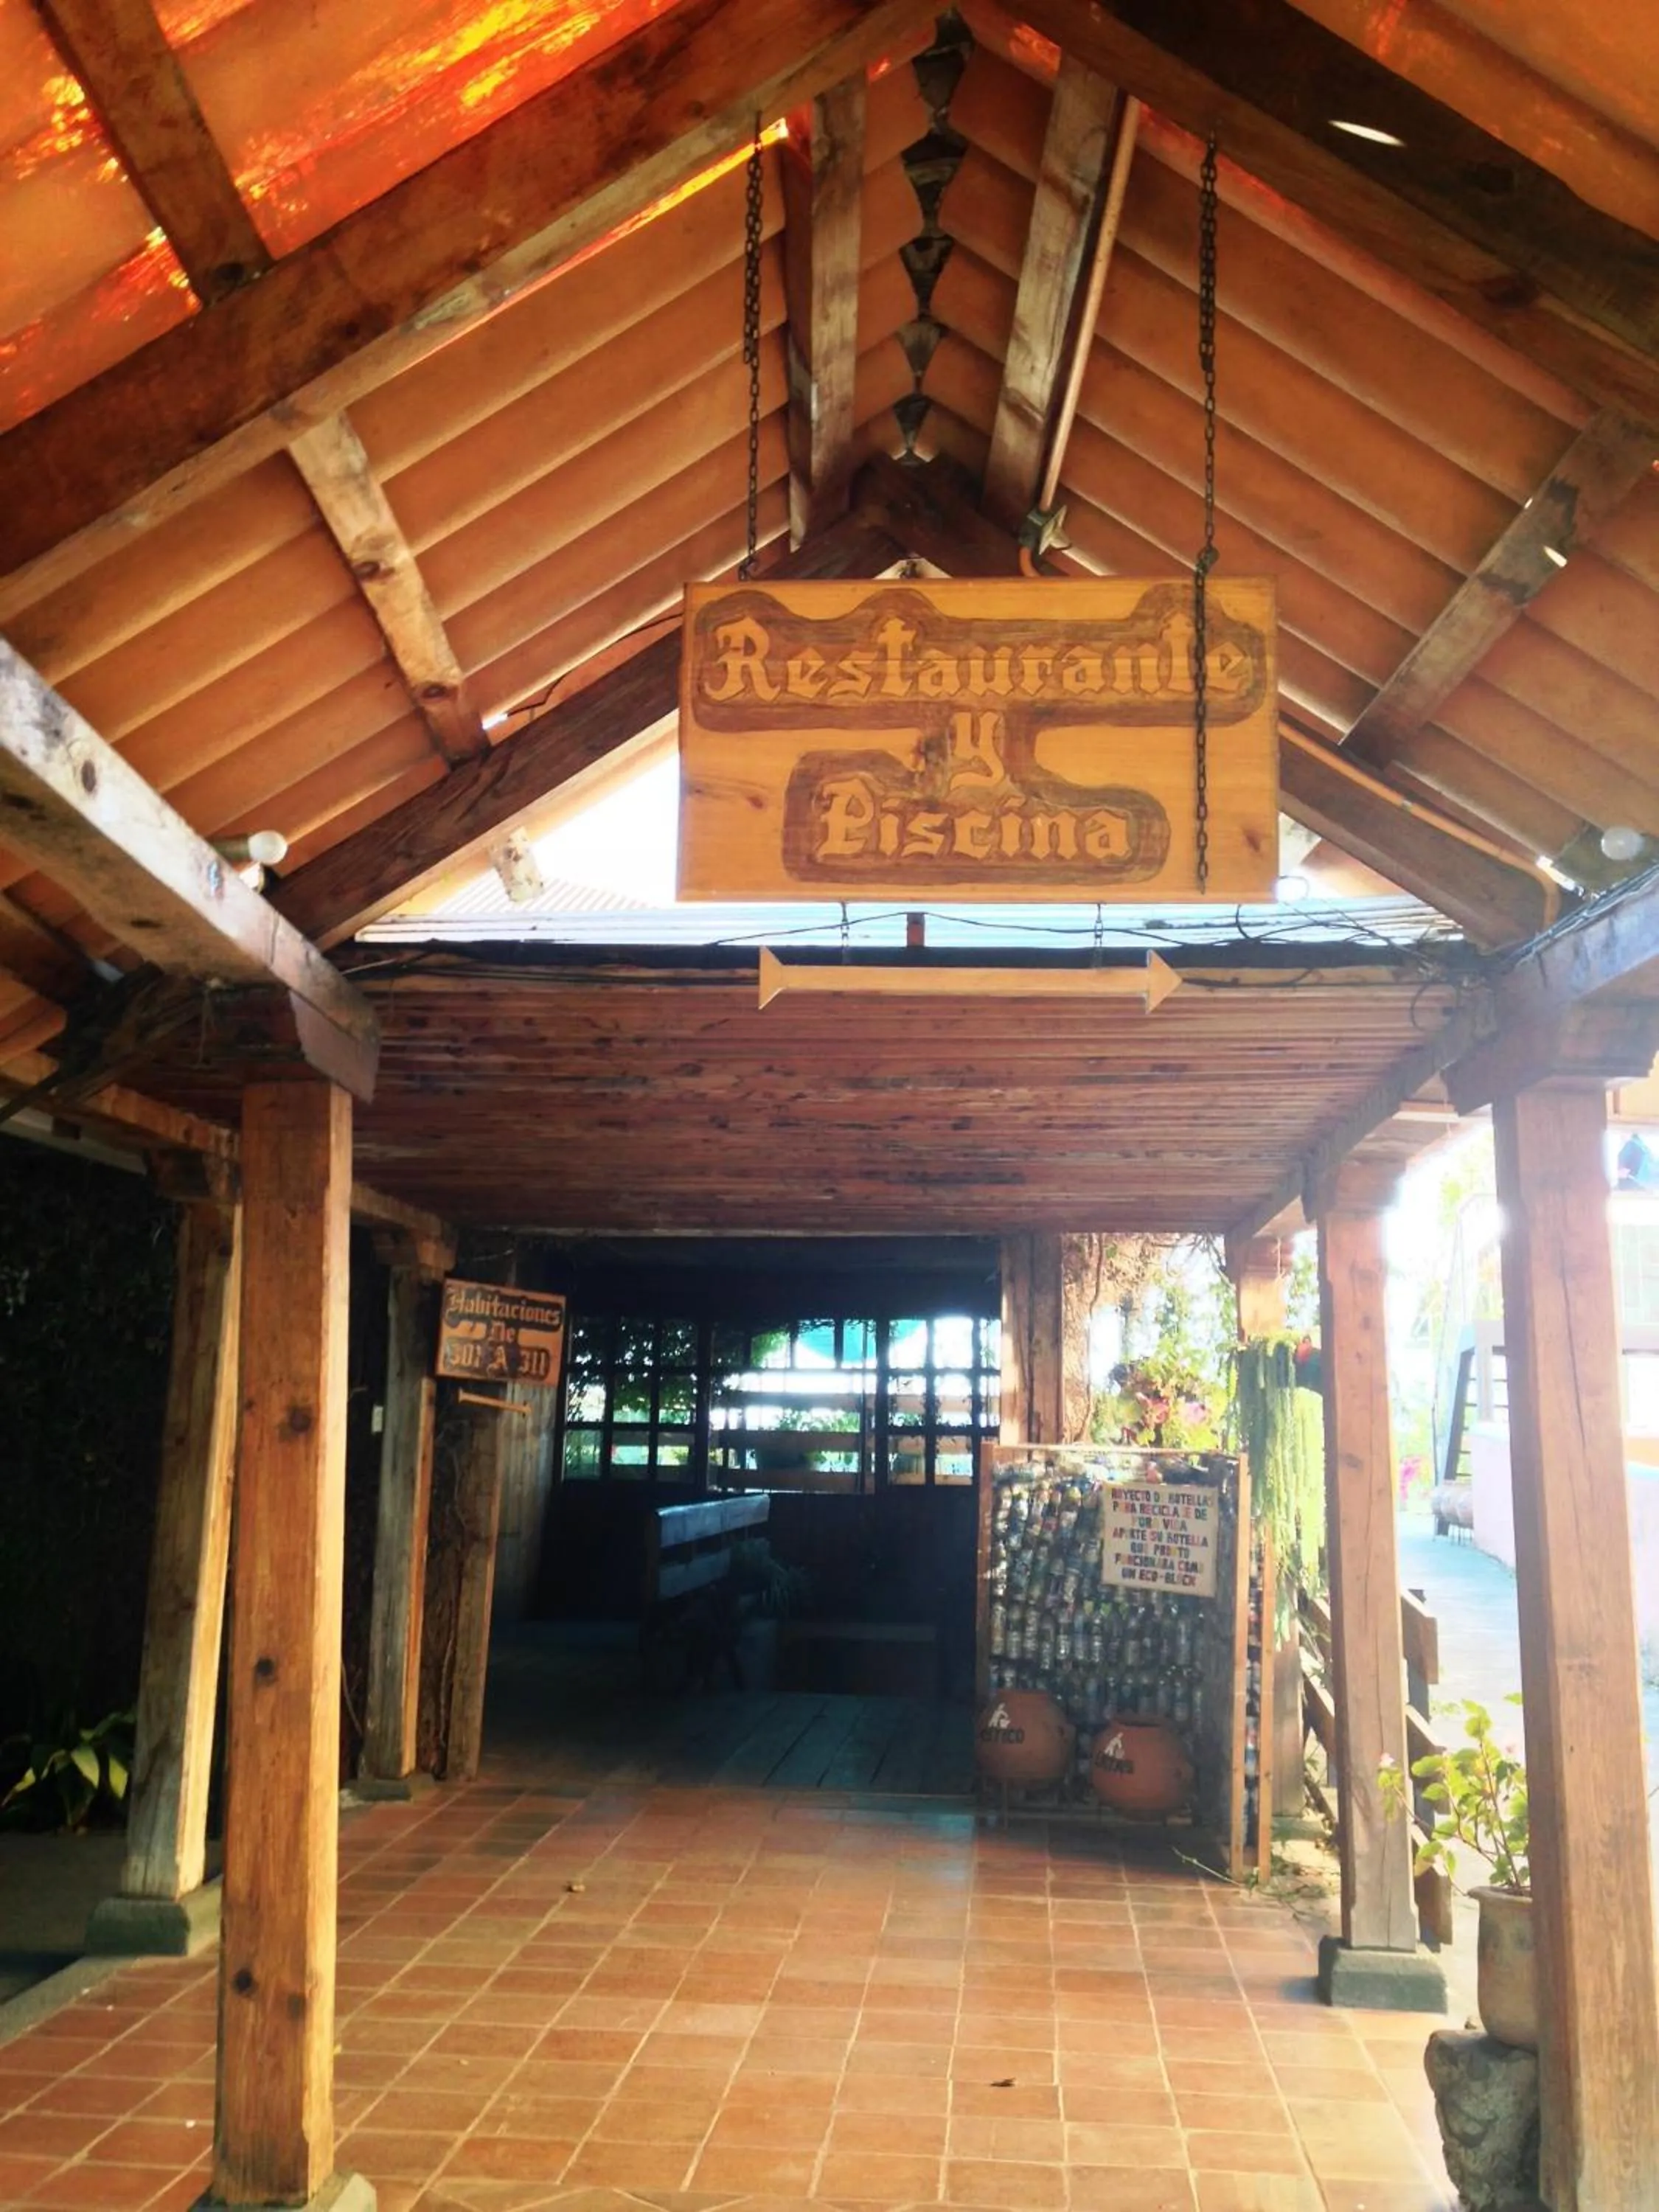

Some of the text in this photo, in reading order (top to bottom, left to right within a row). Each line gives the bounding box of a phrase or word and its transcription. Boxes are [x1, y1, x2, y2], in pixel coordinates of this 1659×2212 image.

[703, 612, 1250, 701] Restaurante
[950, 710, 1006, 790] y
[817, 779, 1132, 861] Piscina
[445, 1287, 561, 1325] Habitaciones
[1106, 1487, 1151, 1502] ROYECTO
[1113, 1501, 1136, 1514] PRA
[1140, 1503, 1192, 1519] RECICLAE
[1163, 1519, 1187, 1532] VIA
[1112, 1528, 1147, 1542] APRTE
[1154, 1544, 1190, 1559] PROTO
[1115, 1553, 1175, 1571] FNCIONRA
[1138, 1568, 1196, 1586] ECO-BLCK
